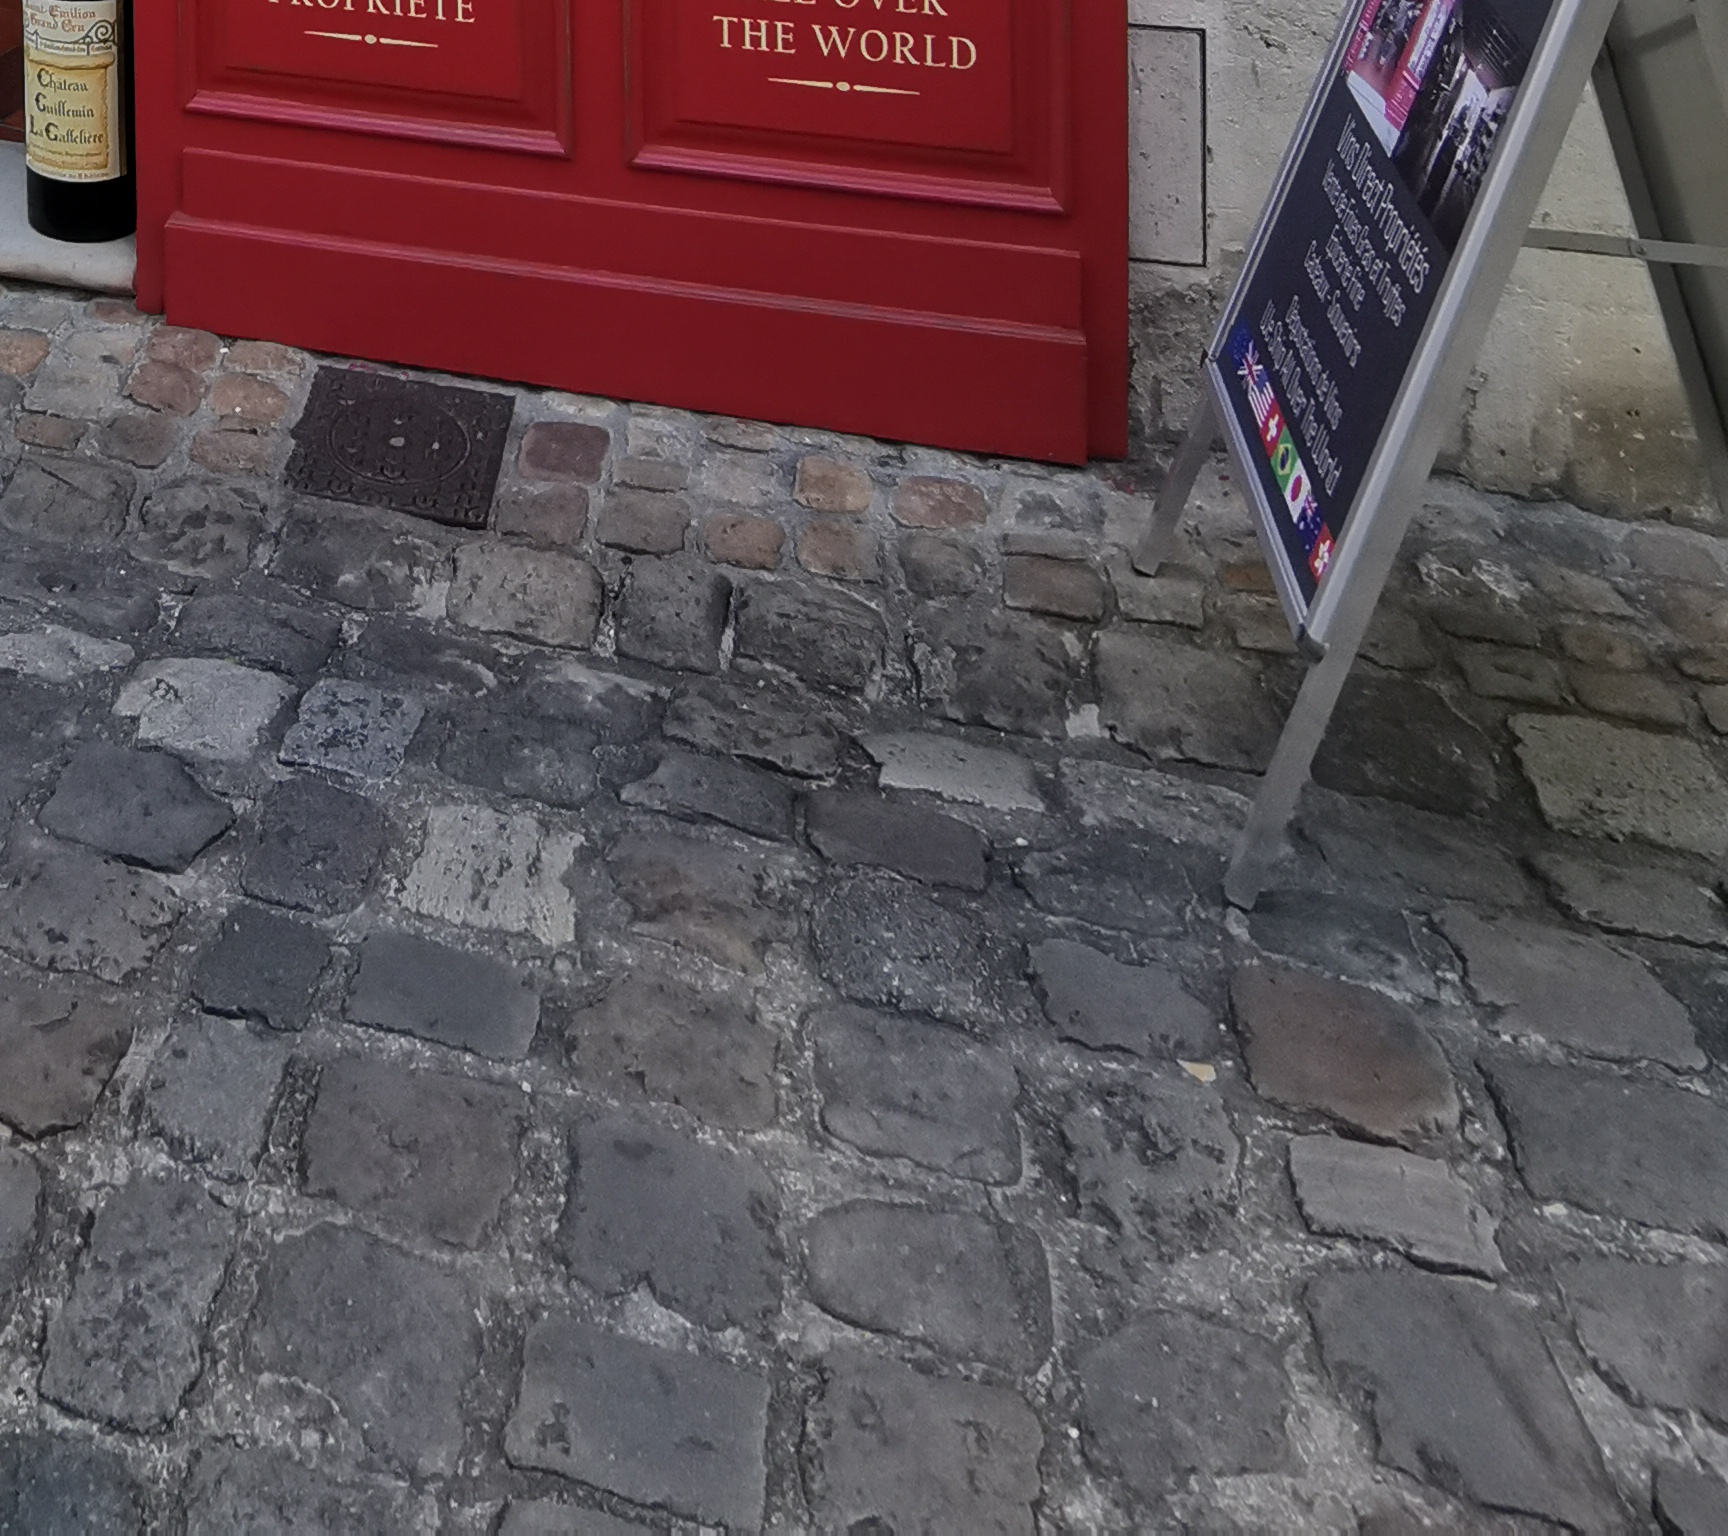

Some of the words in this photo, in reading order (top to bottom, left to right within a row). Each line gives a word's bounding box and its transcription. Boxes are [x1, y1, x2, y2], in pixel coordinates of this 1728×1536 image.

[712, 15, 796, 55] THE
[812, 24, 978, 71] WORLD
[1337, 114, 1360, 170] Vins
[1352, 142, 1384, 213] Direct
[1374, 183, 1429, 293] Propriétés
[1377, 262, 1405, 326] Truffes
[1301, 398, 1317, 446] The
[1312, 425, 1341, 496] World
